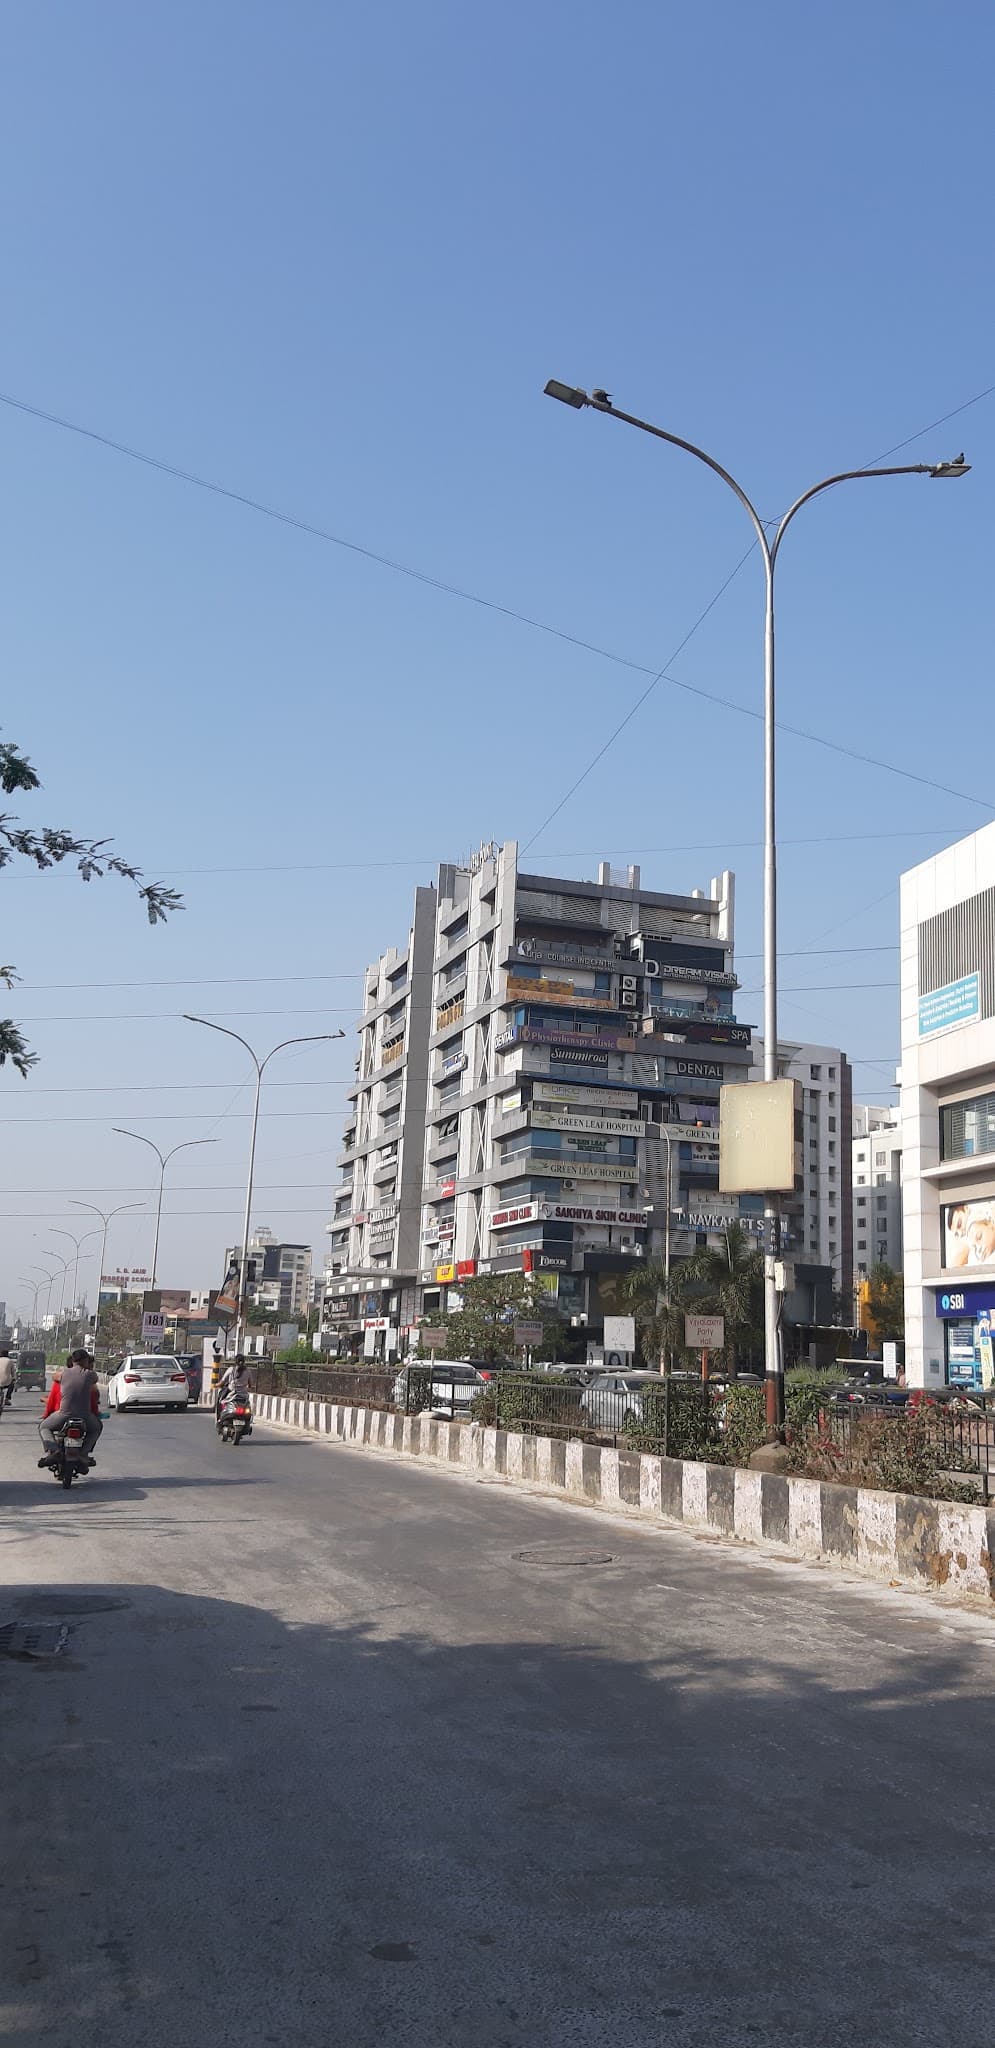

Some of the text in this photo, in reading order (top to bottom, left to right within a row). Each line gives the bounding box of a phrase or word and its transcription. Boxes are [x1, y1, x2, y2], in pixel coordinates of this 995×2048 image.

[663, 965, 737, 981] DREAM VISION
[531, 1031, 615, 1049] Physiotherapy Clinic
[731, 1029, 749, 1041] SPA
[678, 1062, 723, 1077] DENTAL
[557, 1117, 642, 1133] GREEN LEAF HOSPITAL
[685, 1129, 711, 1139] GREEN
[550, 1164, 635, 1179] GREEN LEAF HOSPITAL
[555, 1206, 648, 1225] SAKHIYA SKIN CLINIC
[949, 1293, 965, 1310] SBI
[148, 1314, 164, 1326] 181
